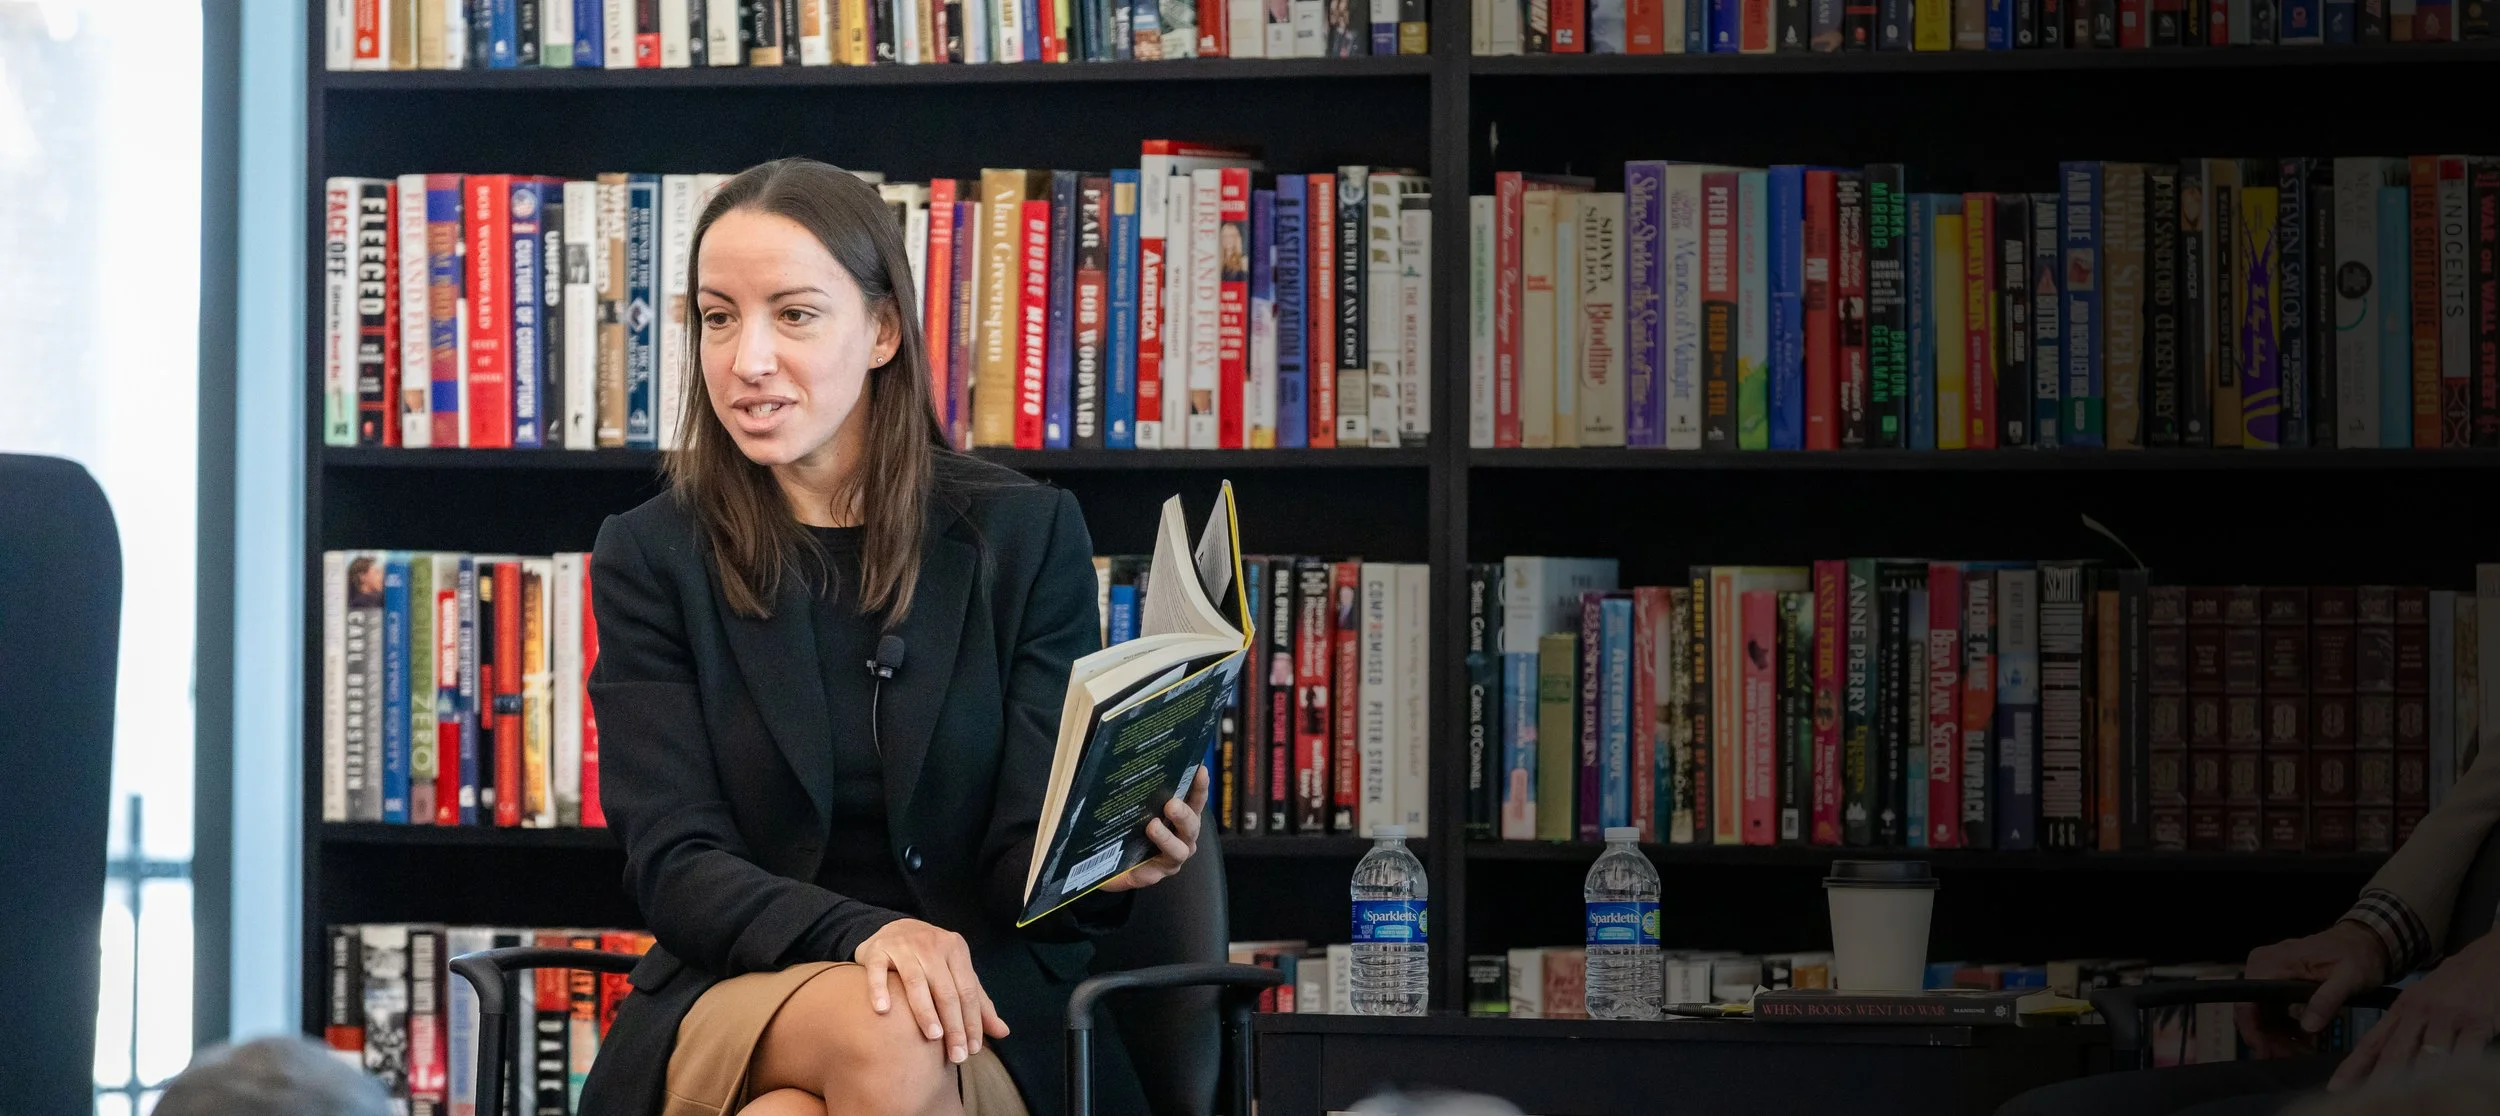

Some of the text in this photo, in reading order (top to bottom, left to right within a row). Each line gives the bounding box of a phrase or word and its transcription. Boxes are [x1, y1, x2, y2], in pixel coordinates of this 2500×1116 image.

[328, 189, 348, 278] FACEOFF
[1708, 186, 1728, 292] PETER ROBINSON
[1838, 206, 1851, 288] Rosenberg
[1849, 206, 1863, 287] Nancy Taylor
[1871, 182, 1889, 249] MIRROR
[1890, 191, 1907, 238] DARK
[2036, 202, 2058, 258] ANN RULE
[2067, 171, 2091, 241] ANN RULE
[2105, 171, 2126, 253] SAFIRE
[2127, 171, 2146, 252] WILLIAM
[2480, 194, 2496, 242] WAR
[360, 198, 387, 315] FLEECED
[477, 186, 491, 330] BOB WOODWARD
[983, 189, 1015, 364] Alan Greenspan
[1197, 187, 1218, 370] FIRE AND FURY
[1279, 214, 1301, 358] EASTERNIZATION
[1584, 206, 1600, 295] SHELDON
[1599, 217, 1613, 284] SIDNEY
[2186, 236, 2198, 300] SLANDER
[2280, 177, 2302, 332] STEVEN SAYLOR
[2480, 248, 2493, 273] on
[515, 240, 535, 418] CULTURE OF CORRUPTION
[1023, 219, 1046, 416] DRUDGE MANIFESTO
[1077, 189, 1101, 438] FEAR BOB WOODWARD
[1142, 249, 1162, 342] AMERICA
[1343, 221, 1358, 368] TRUTH AT ANY COST
[1708, 305, 1728, 351] FRIEND
[2152, 175, 2175, 419] JOHN SANDFORD CHOSEN PREY
[2413, 183, 2437, 415] LISA SCOTTOLINE EXPOSED
[2480, 280, 2497, 335] WALL
[1405, 286, 1418, 416] THE WRECKING CREW
[1583, 303, 1615, 386] Bloodline
[1871, 324, 1889, 403] GELLMAN
[1890, 329, 1907, 397] BARTON
[2037, 345, 2059, 400] HARVEST
[2111, 263, 2141, 412] SLEEPER SPY
[2481, 341, 2497, 410] STREET
[1840, 381, 1851, 412] law
[1851, 351, 1865, 422] sullivan's
[2291, 339, 2302, 419] THE JUDGMENT
[1275, 569, 1289, 596] BILL
[1470, 580, 1485, 653] SHELL GAME
[1694, 578, 1705, 638] STEWART
[1819, 572, 1837, 681] ANNE PERRY
[1849, 573, 1868, 716] ANNE PERRY
[1967, 579, 1990, 692] VALERIE PLAME
[347, 611, 366, 790] CARL BERNSTEIN
[412, 694, 436, 772] ZERO
[1342, 640, 1357, 794] WINNING THE FUTURE
[1368, 581, 1385, 805] COMPROMISED PETER STRZOK
[1609, 648, 1628, 781] ARTEMIS FOWL
[1695, 715, 1706, 744] CITY
[1930, 629, 1957, 783] BELVA PLAIN SECRECY
[1470, 685, 1485, 791] CAROL O'CONNELL
[1695, 749, 1706, 765] OF
[1758, 682, 1771, 797] UNLUCKY IN LAW
[1815, 737, 1825, 812] LISSON GROVE
[1824, 745, 1836, 790] TREASON
[1963, 731, 1985, 822] BLOWBACK
[2000, 738, 2015, 767] GATE
[2014, 712, 2032, 795] BRANDENBURG
[2042, 661, 2082, 820] THE BURDEN OF PROOF
[1695, 770, 1706, 830] SECRETS
[1367, 911, 1417, 924] Sparkletts
[1591, 913, 1640, 926] Sparkletts
[1762, 1003, 1803, 1017] WHEN
[1807, 1003, 1852, 1017] BOOKS
[1855, 1003, 1892, 1017] WENT
[1895, 1003, 1916, 1017] TO
[1916, 1003, 1946, 1017] WAR
